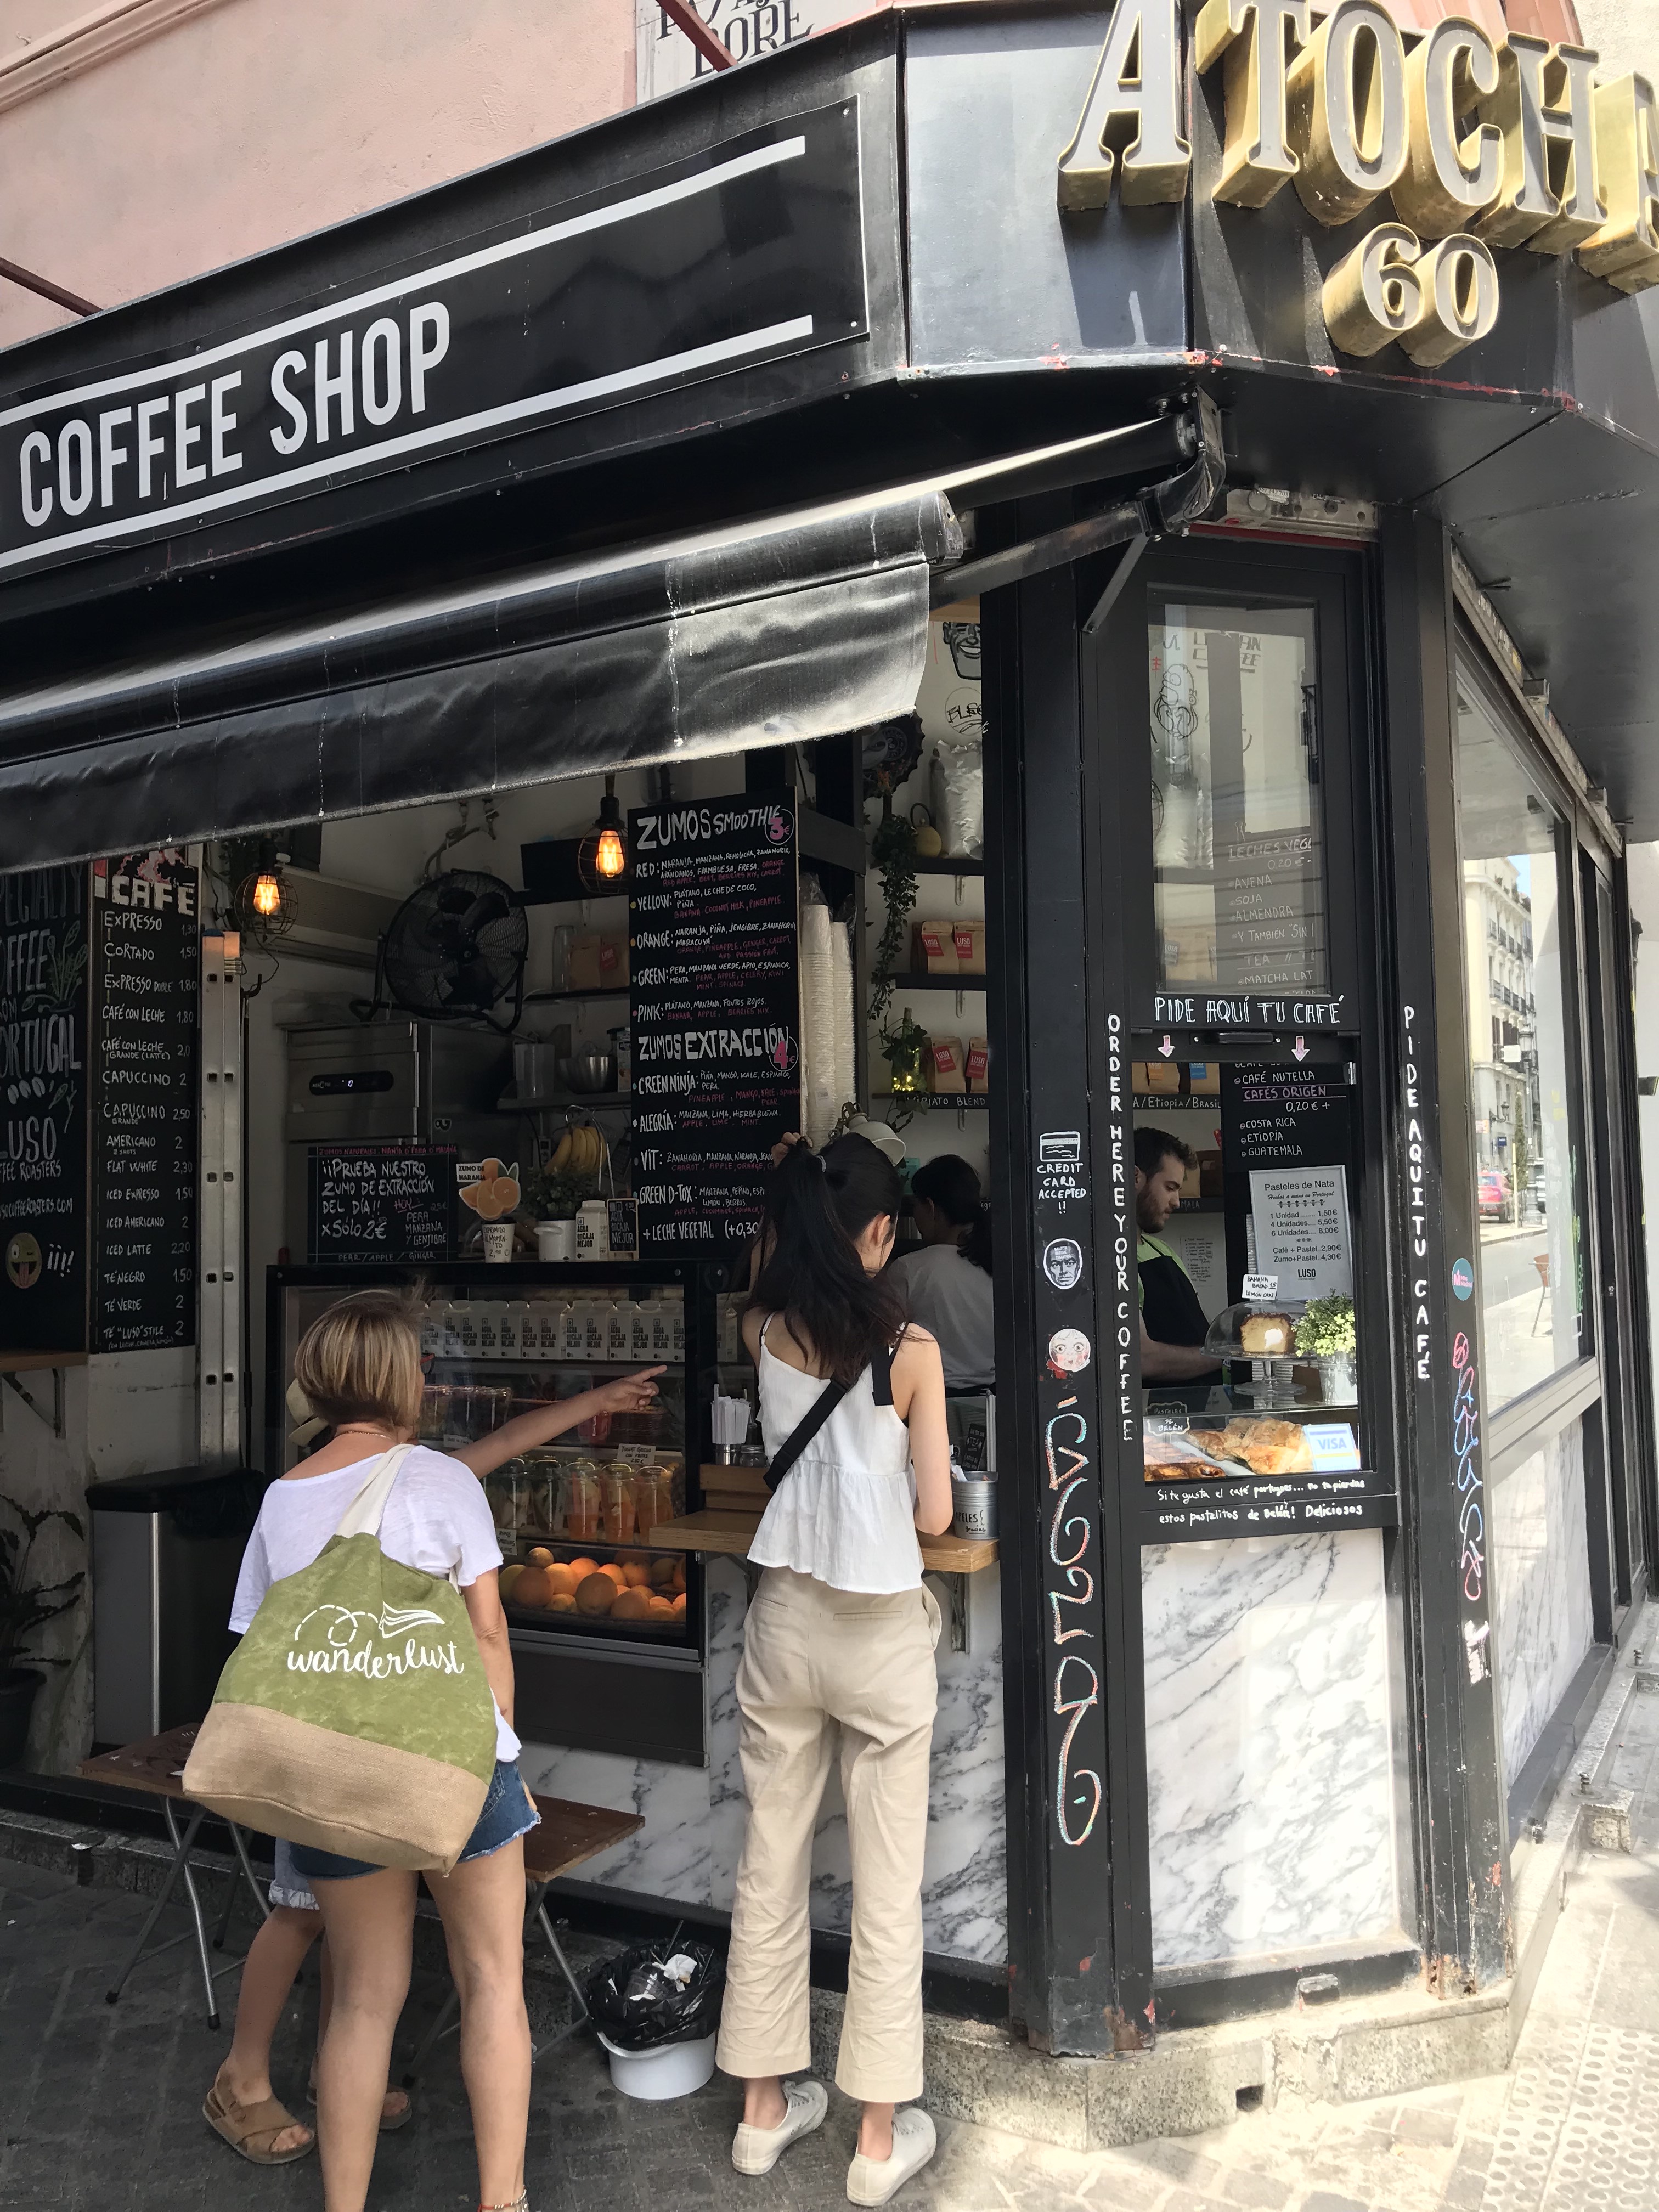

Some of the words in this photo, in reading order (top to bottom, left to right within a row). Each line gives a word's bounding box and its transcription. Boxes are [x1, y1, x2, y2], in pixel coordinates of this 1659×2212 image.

[1336, 222, 1498, 354] 60
[20, 370, 243, 528] COFFEE
[270, 301, 450, 455] SHOP
[637, 809, 712, 849] ZUMOS
[1228, 842, 1281, 859] LECHES
[1234, 874, 1272, 890] AVENA
[1235, 894, 1262, 905] SOJA
[1235, 906, 1294, 922] ALMENDRA
[104, 943, 154, 960] CORTADO
[1244, 972, 1289, 985] MATCHA
[103, 1003, 125, 1020] CAFÉ
[126, 1008, 139, 1020] CON
[142, 1007, 165, 1023] LECHE
[1154, 997, 1196, 1023] PIDE
[1206, 996, 1250, 1023] AQUÍ
[1257, 1002, 1285, 1023] TU
[1294, 994, 1345, 1024] CAFÉ
[122, 1042, 136, 1051] CON
[138, 1040, 164, 1052] LECHE
[639, 1034, 681, 1060] ZUMOS
[110, 1051, 139, 1059] GRANDE
[936, 1050, 949, 1059] LUSO
[971, 1056, 985, 1064] LUSO
[1404, 1005, 1419, 1108] PIDE
[1108, 1014, 1122, 1112] ORDER
[103, 1070, 171, 1085] CAPUCCINO
[179, 1073, 187, 1086] 2
[1242, 1071, 1266, 1084] CAFÉ
[1273, 1070, 1315, 1082] NUTELLA
[1244, 1086, 1278, 1099] CAFÉS
[1283, 1085, 1326, 1098] ORIGEN
[957, 1097, 986, 1106] BLEND
[104, 1103, 165, 1119] CAPUCCINO
[1245, 1119, 1272, 1128] COSTA
[1276, 1118, 1296, 1127] RICA
[0, 1116, 57, 1163] USO
[106, 1135, 156, 1148] AMERICANO
[175, 1136, 183, 1149] 2
[1248, 1144, 1303, 1156] GUATEMALA
[20, 1159, 61, 1181] ROASTERS
[107, 1160, 126, 1173] FLAT
[129, 1160, 158, 1173] WHITE
[382, 1160, 426, 1177] NUESTRO
[1037, 1163, 1083, 1174] CREDIT
[1110, 1125, 1125, 1207] HERE
[1408, 1119, 1424, 1206] AQUI
[322, 1182, 356, 1196] ZUMO
[362, 1181, 376, 1196] DE
[379, 1175, 435, 1197] EXTRACCIÓN
[1043, 1176, 1076, 1187] CARD
[1265, 1182, 1300, 1191] Pasteles
[106, 1189, 122, 1200] ICED
[640, 1185, 665, 1204] GREEN
[1038, 1189, 1086, 1200] ACCEPTED
[323, 1199, 345, 1214] DEL
[106, 1217, 122, 1228] ICED
[125, 1215, 165, 1228] AMERICANO
[182, 1216, 189, 1228] 2
[407, 1211, 428, 1222] PERA
[405, 1221, 443, 1234] MANZANA
[653, 1223, 676, 1240] LECHE
[679, 1221, 714, 1240] VEGETAL
[406, 1235, 411, 1245] Y
[612, 1232, 634, 1244] MEJOR
[1412, 1216, 1426, 1256] TU
[106, 1245, 123, 1255] ICED
[127, 1244, 152, 1256] LATTE
[409, 1250, 436, 1260] GINGER
[1114, 1214, 1130, 1291] YOUR
[117, 1271, 145, 1284] NEGRO
[1298, 1269, 1316, 1278] LUSO
[117, 1297, 142, 1311] VERDE
[176, 1295, 183, 1308] 2
[174, 1320, 184, 1335] 2
[1414, 1279, 1430, 1379] CAFÉ
[1117, 1302, 1133, 1441] COFFEE
[1158, 1423, 1183, 1431] BELÉN
[1317, 1437, 1347, 1450] VISA
[1182, 1488, 1210, 1504] gusta
[1215, 1488, 1223, 1498] el
[1230, 1485, 1250, 1497] café
[1159, 1514, 1185, 1523] estos
[1190, 1510, 1238, 1526] pastelitos
[1248, 1509, 1259, 1521] de
[1306, 1502, 1363, 1518] Deliciosos
[287, 1638, 465, 1679] wanderlust
